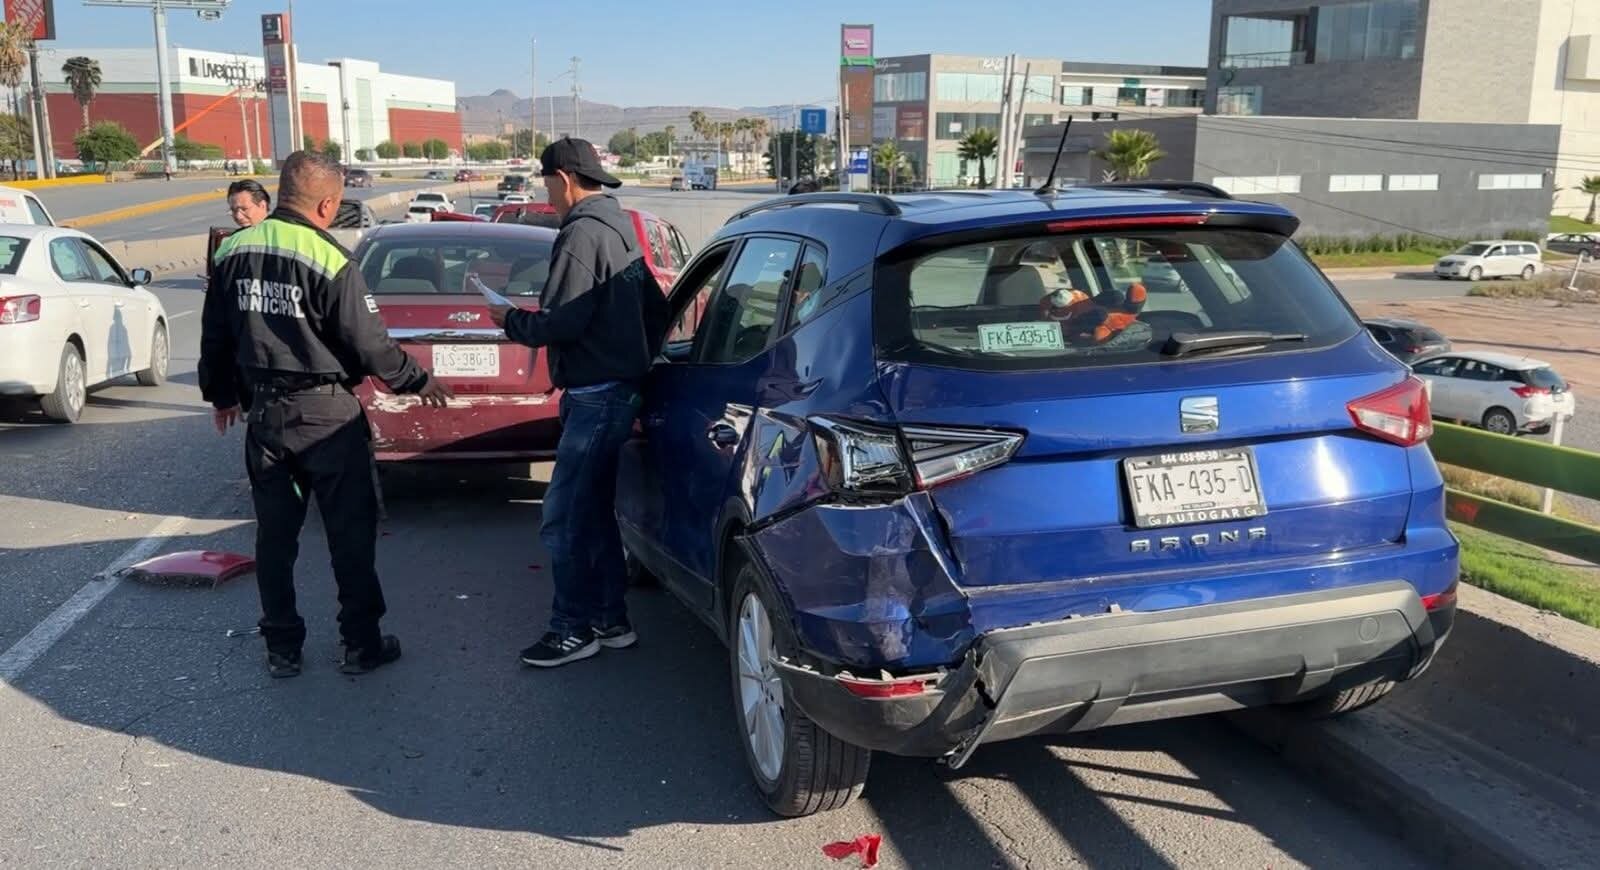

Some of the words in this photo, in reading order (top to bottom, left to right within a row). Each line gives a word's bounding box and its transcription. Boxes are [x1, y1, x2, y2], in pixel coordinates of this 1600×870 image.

[987, 329, 1057, 345] FKA-435-D
[1133, 465, 1252, 503] FKA-435-D
[1166, 508, 1241, 525] AUTOGAR
